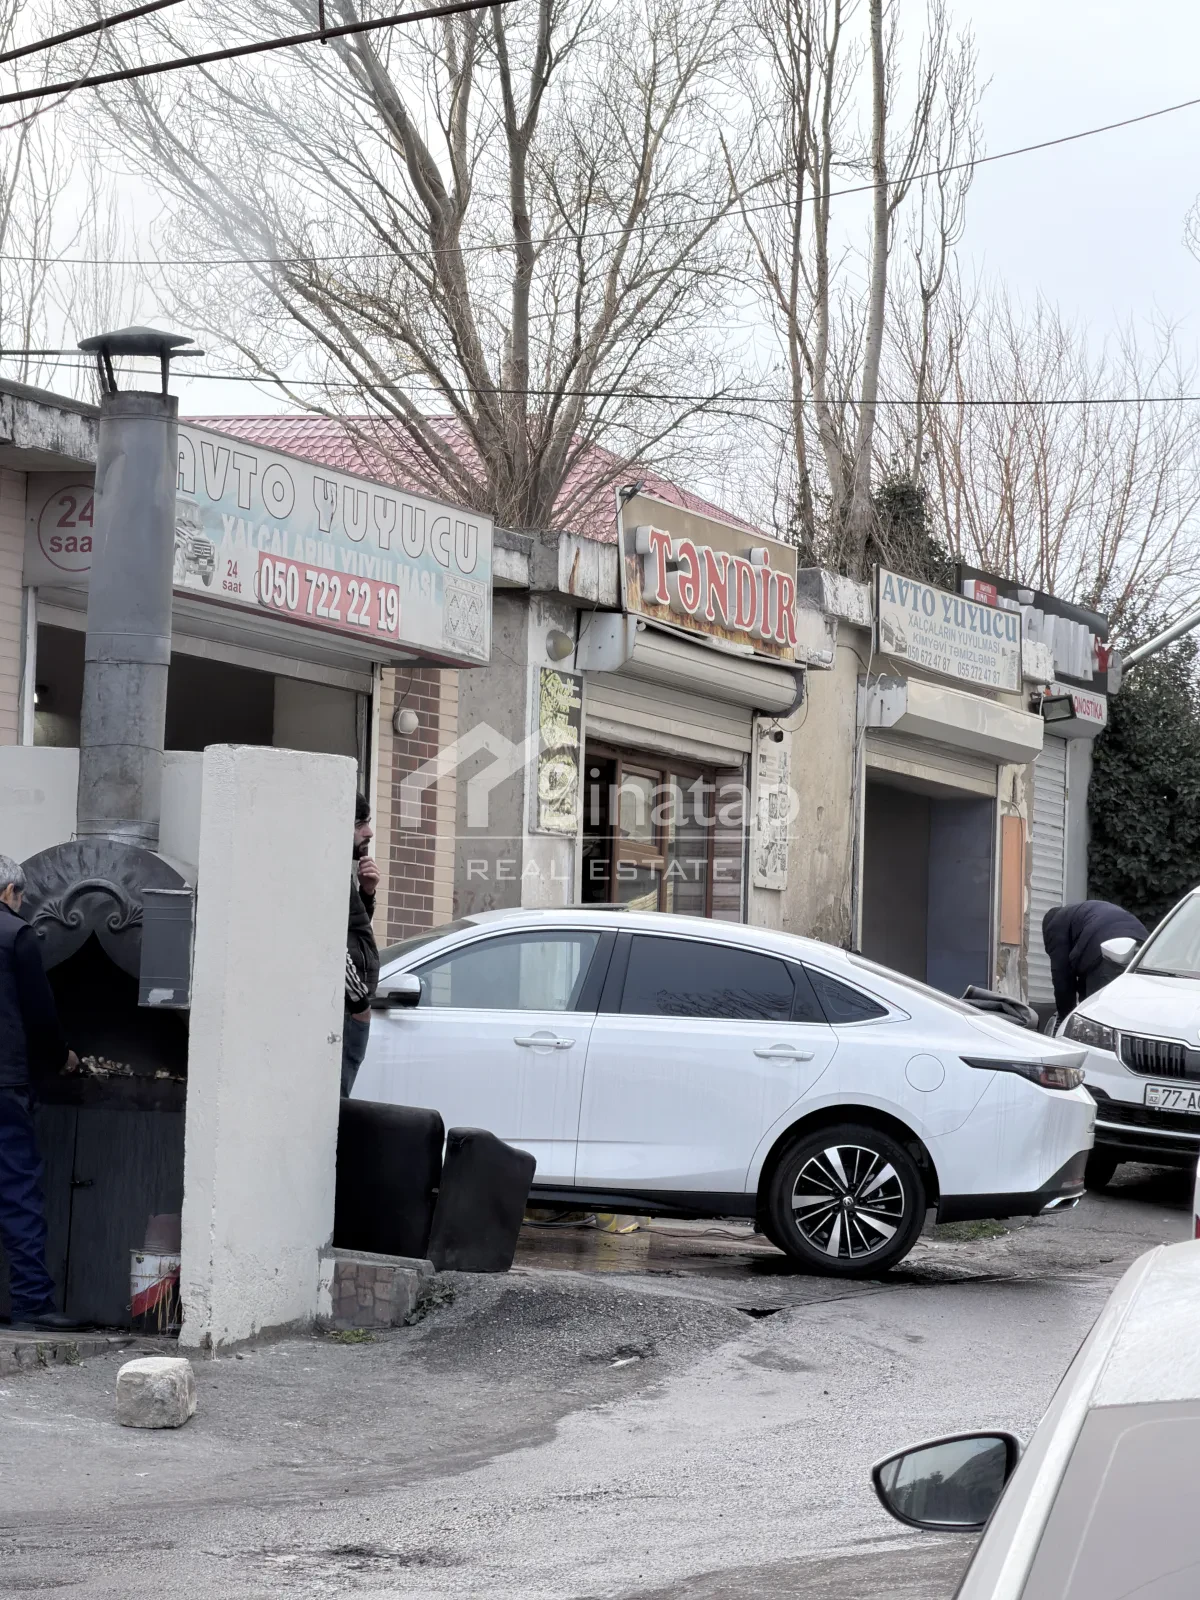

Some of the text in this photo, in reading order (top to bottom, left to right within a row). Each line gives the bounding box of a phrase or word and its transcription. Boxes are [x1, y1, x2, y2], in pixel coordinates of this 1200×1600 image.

[56, 495, 94, 528] 24
[176, 433, 478, 574] AVTO YUYUCU
[49, 535, 93, 553] saa
[227, 559, 238, 578] 24
[222, 580, 242, 594] saat
[260, 557, 399, 632] 050 722 22 19
[882, 574, 936, 617] AVTO
[940, 595, 1017, 643] YUYUCU
[907, 644, 1000, 684] 050 672 47 87 055 272 47 87
[1161, 1089, 1200, 1109] 77-A
